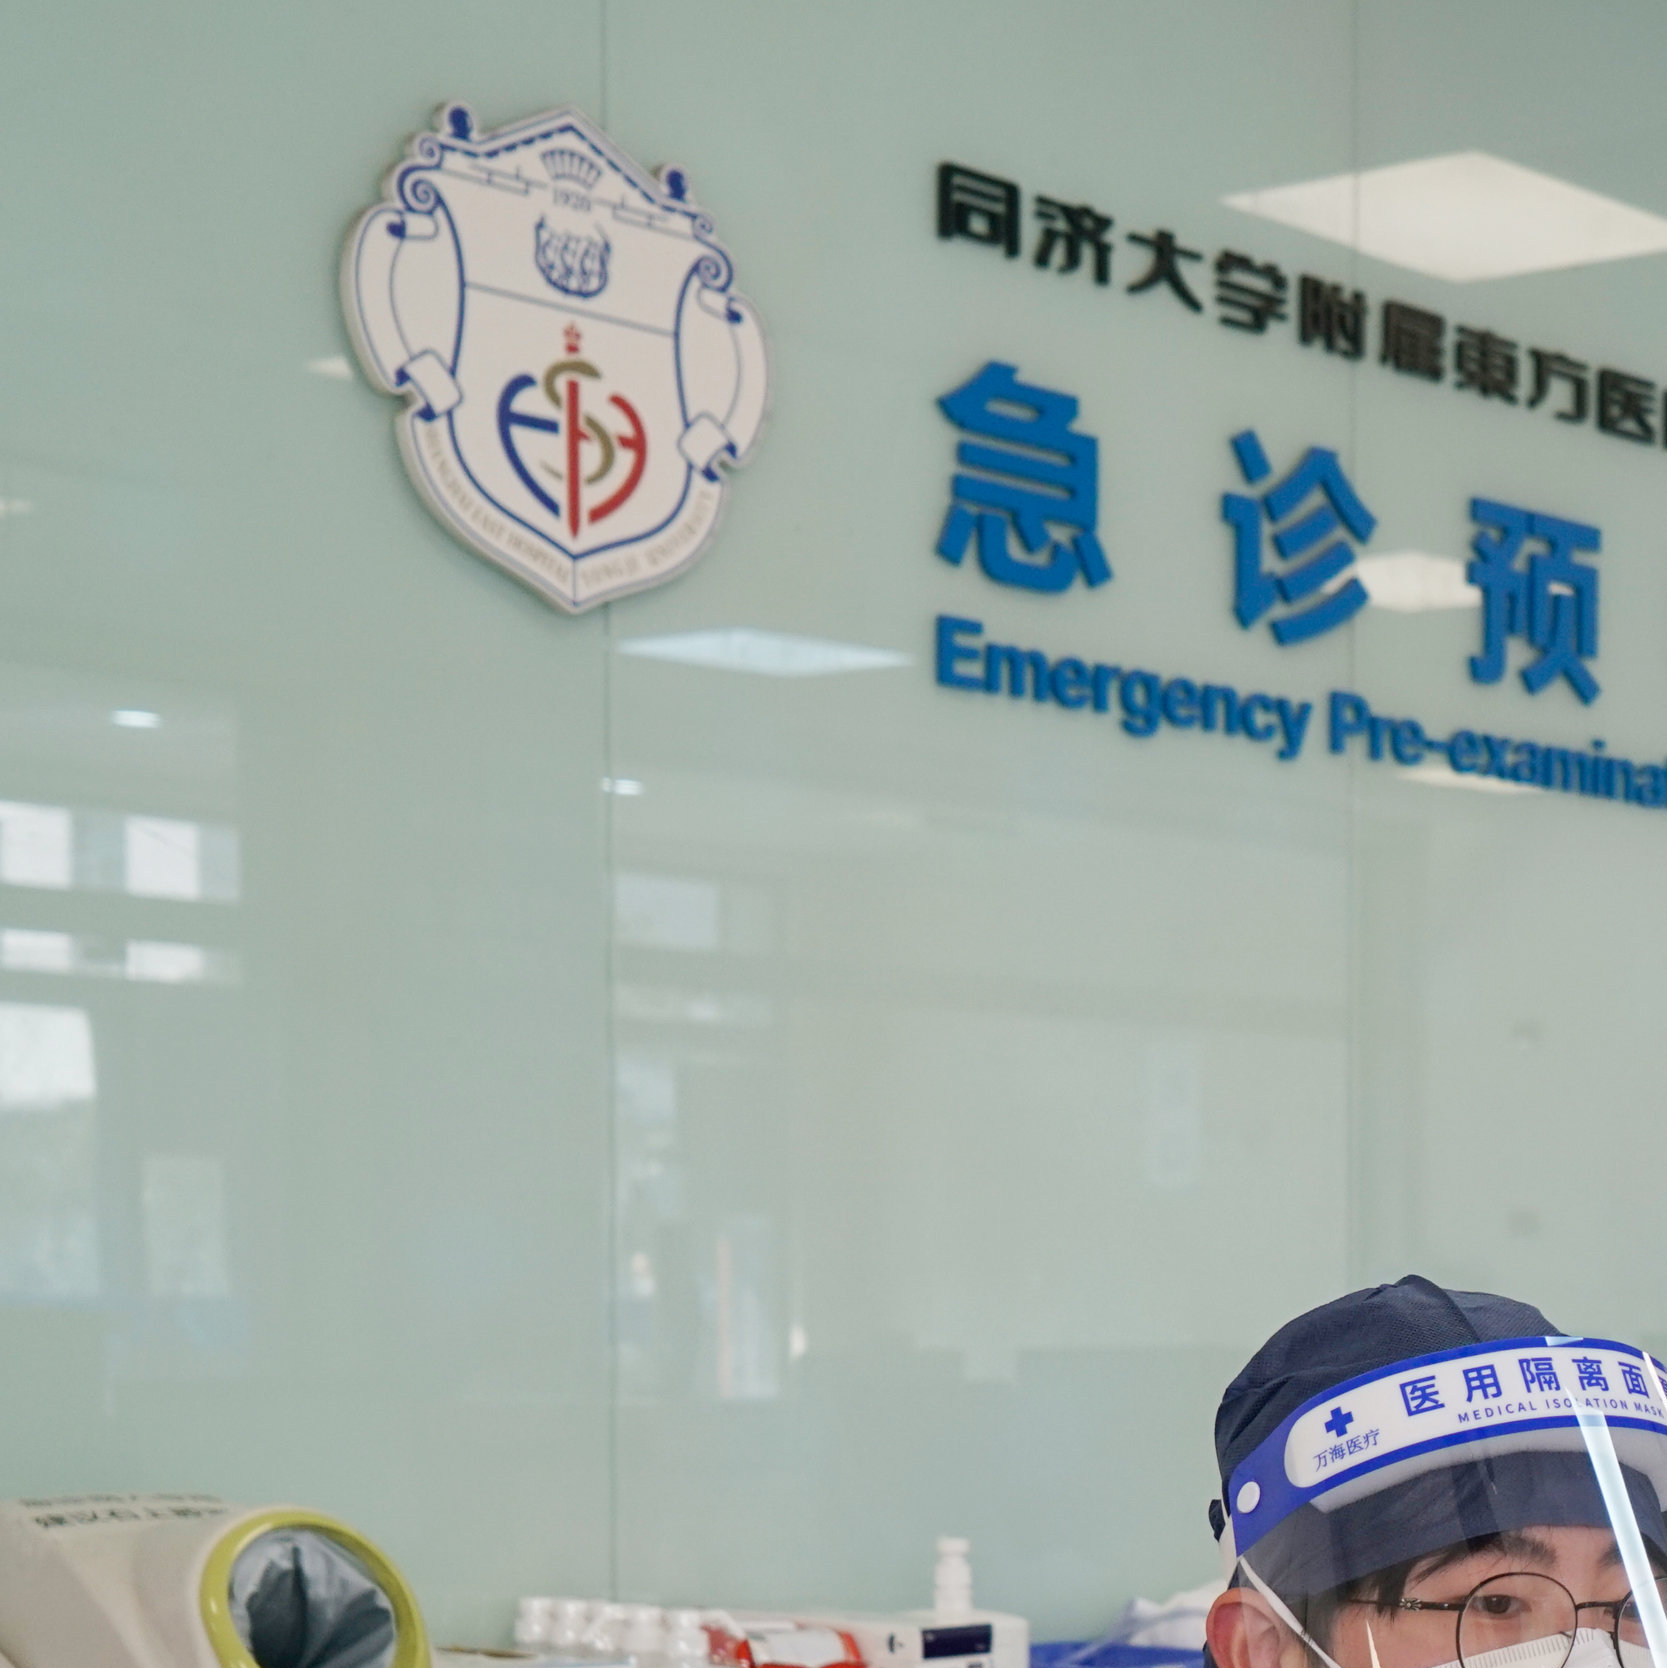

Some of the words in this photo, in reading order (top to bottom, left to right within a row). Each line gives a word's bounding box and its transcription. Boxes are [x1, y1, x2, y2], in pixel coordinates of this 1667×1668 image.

[936, 614, 1311, 760] Emergency
[1458, 1402, 1536, 1424] MEDICAL
[1546, 1397, 1628, 1410] ISOATION
[1634, 1402, 1665, 1418] MASK
[1313, 1428, 1380, 1472] 万海医疗
